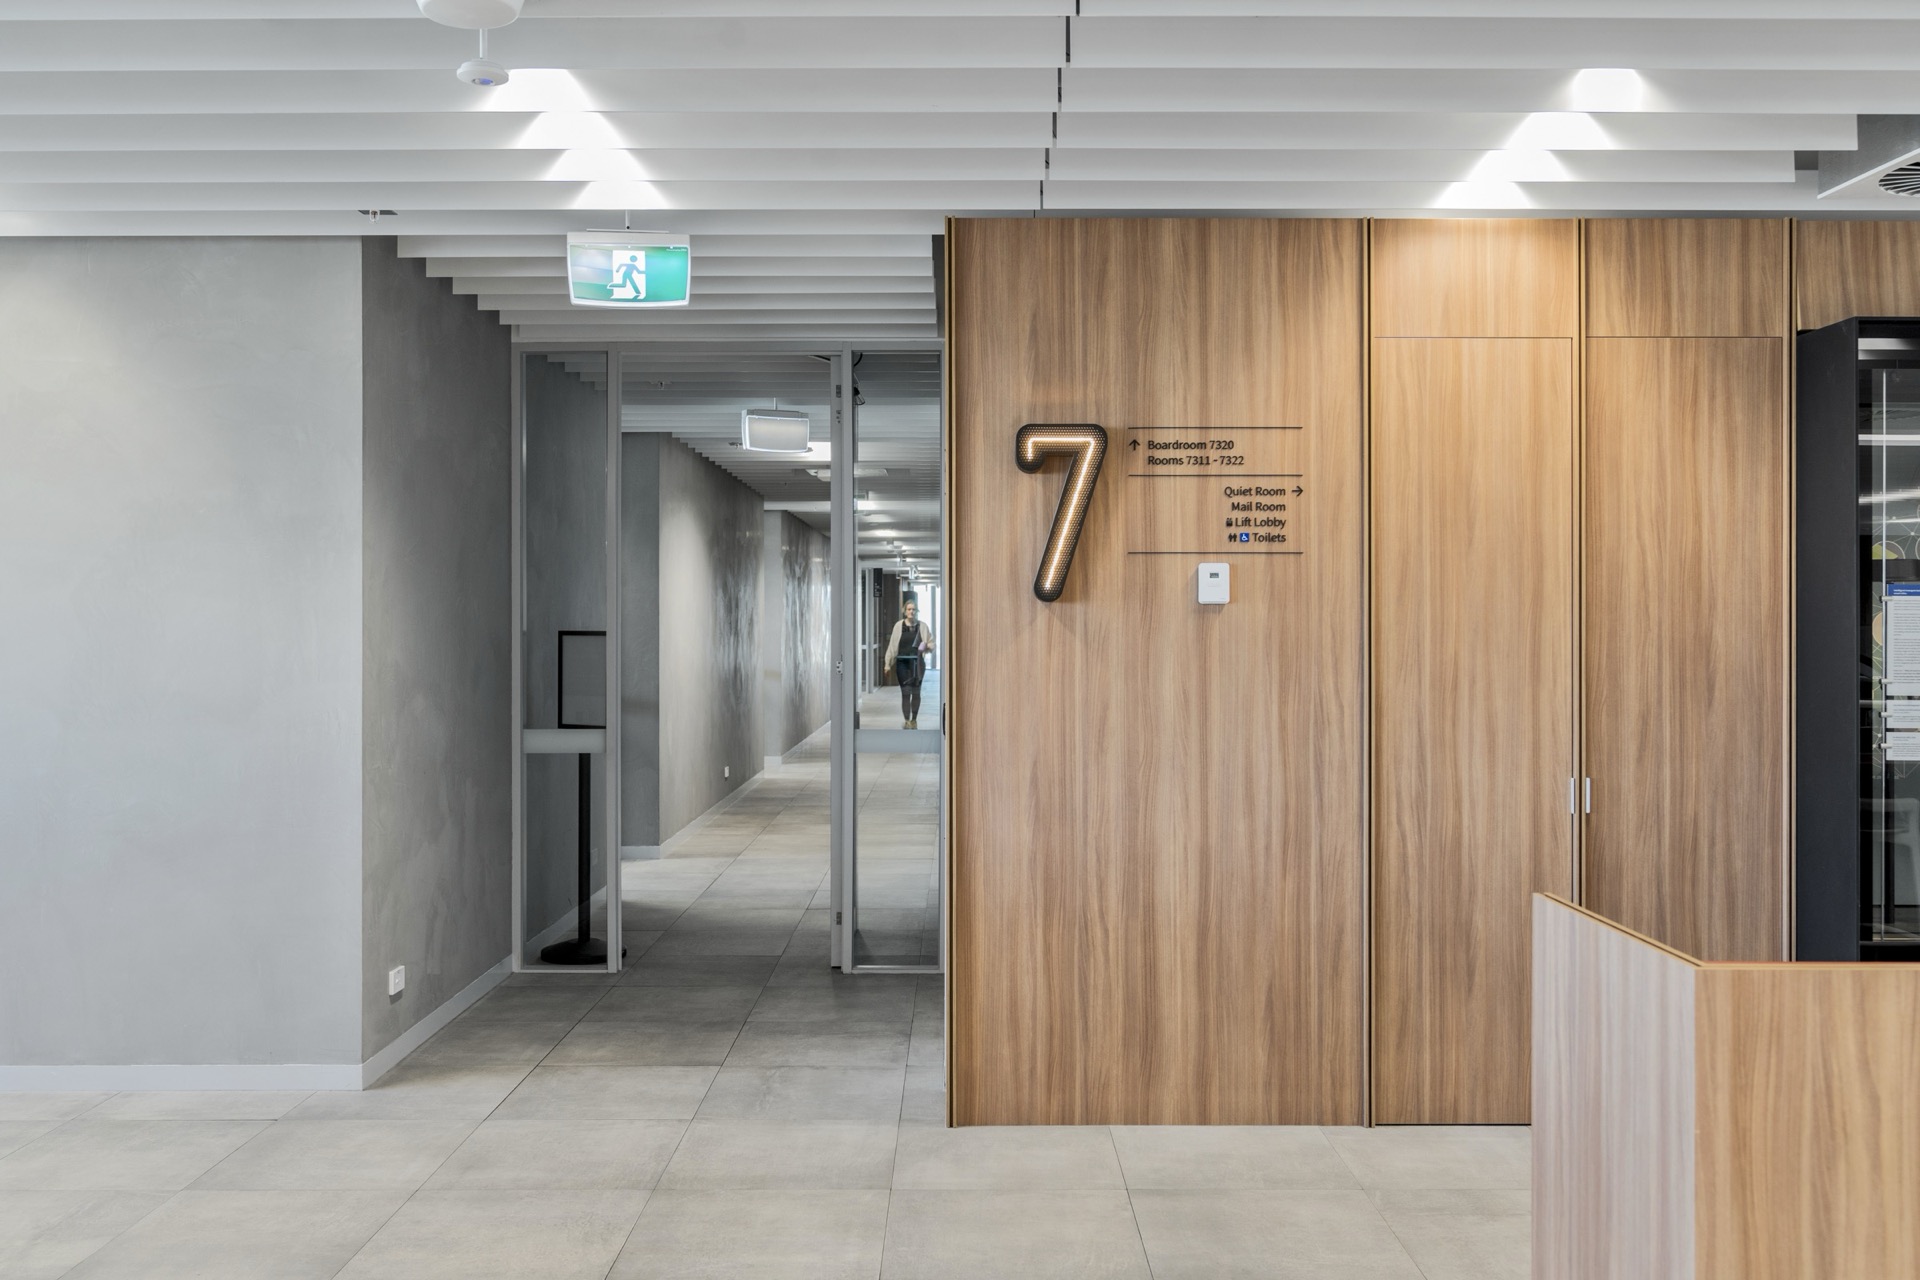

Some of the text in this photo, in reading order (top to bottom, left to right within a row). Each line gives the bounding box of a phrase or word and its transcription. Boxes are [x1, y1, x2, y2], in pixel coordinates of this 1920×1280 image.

[1148, 440, 1235, 450] Boardroom 7320
[1148, 456, 1184, 466] Rooms
[1186, 456, 1211, 465] 7311
[1220, 456, 1245, 466] 7322
[1224, 486, 1286, 498] Quiet Room
[1231, 502, 1286, 512] Mail Room
[1016, 424, 1108, 602] 7
[1235, 516, 1286, 530] Lift Lobby
[1252, 532, 1287, 543] Toilets
